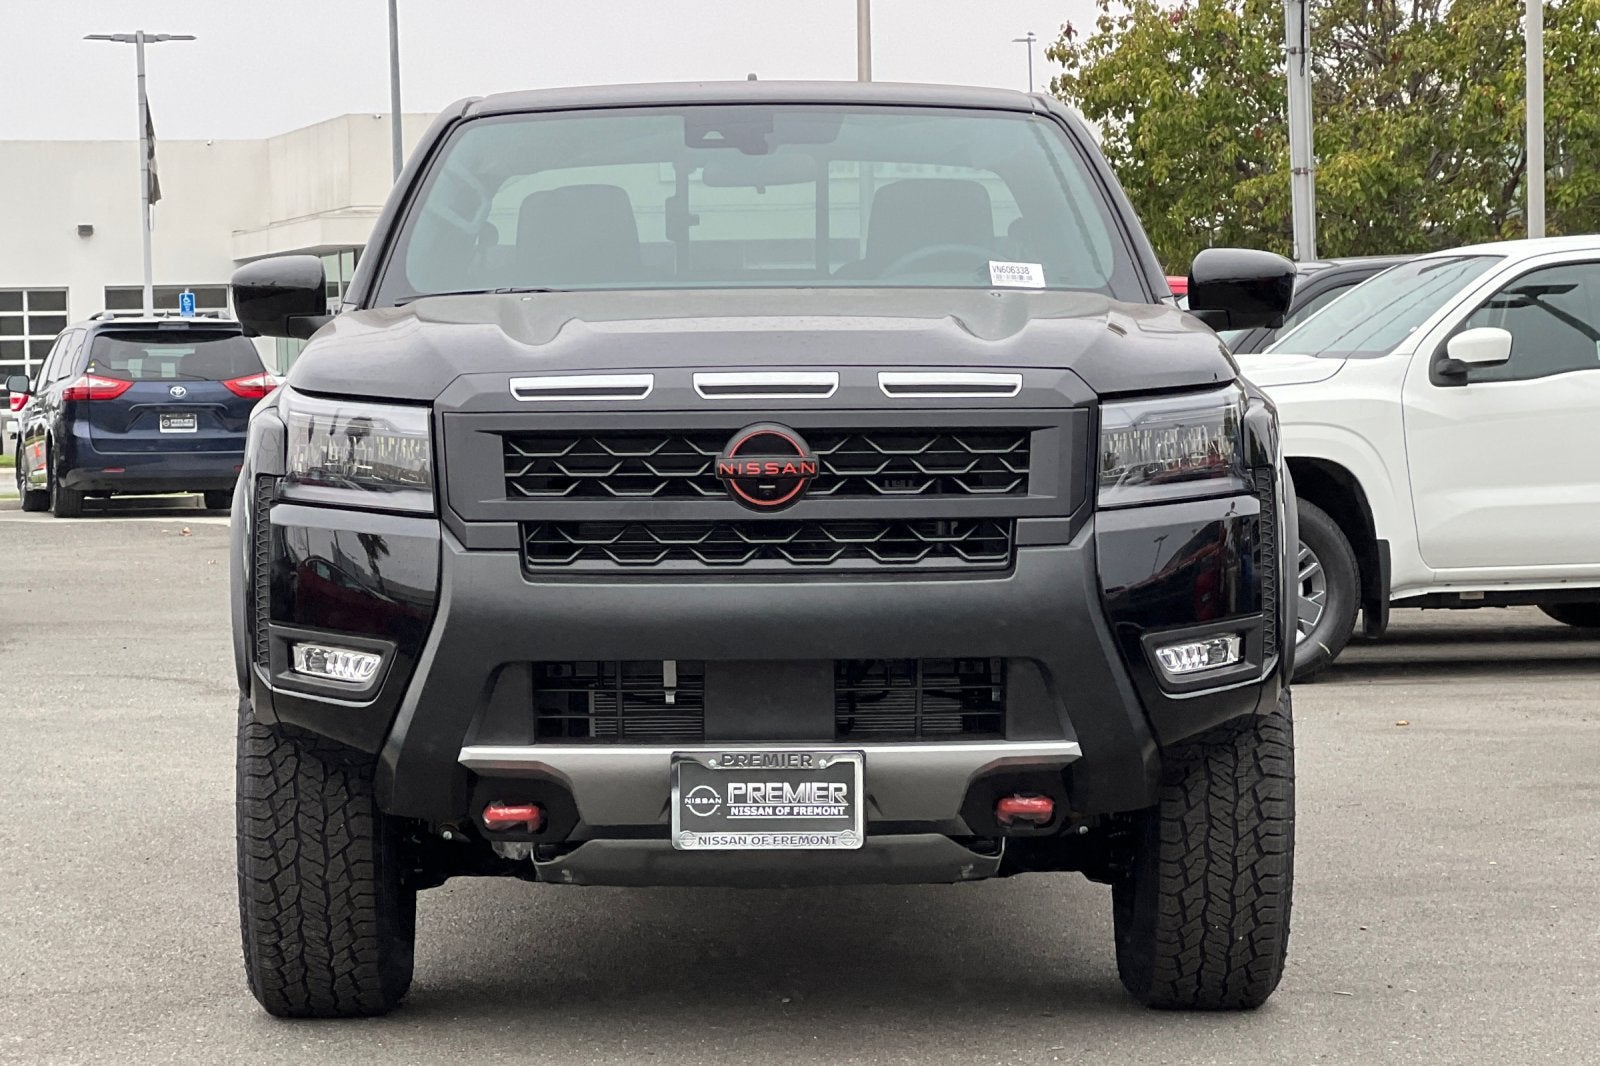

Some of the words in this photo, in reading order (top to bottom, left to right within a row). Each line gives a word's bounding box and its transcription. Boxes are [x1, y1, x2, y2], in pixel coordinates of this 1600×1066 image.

[720, 462, 816, 475] NISSAN
[722, 754, 813, 766] PREMIER
[727, 782, 847, 804] PREMIER
[730, 806, 772, 816] NISSAN
[776, 806, 791, 816] OF
[793, 806, 845, 816] FREMONT
[698, 836, 747, 846] NISSAN
[751, 836, 769, 844] OF
[774, 835, 838, 844] FREMONT
